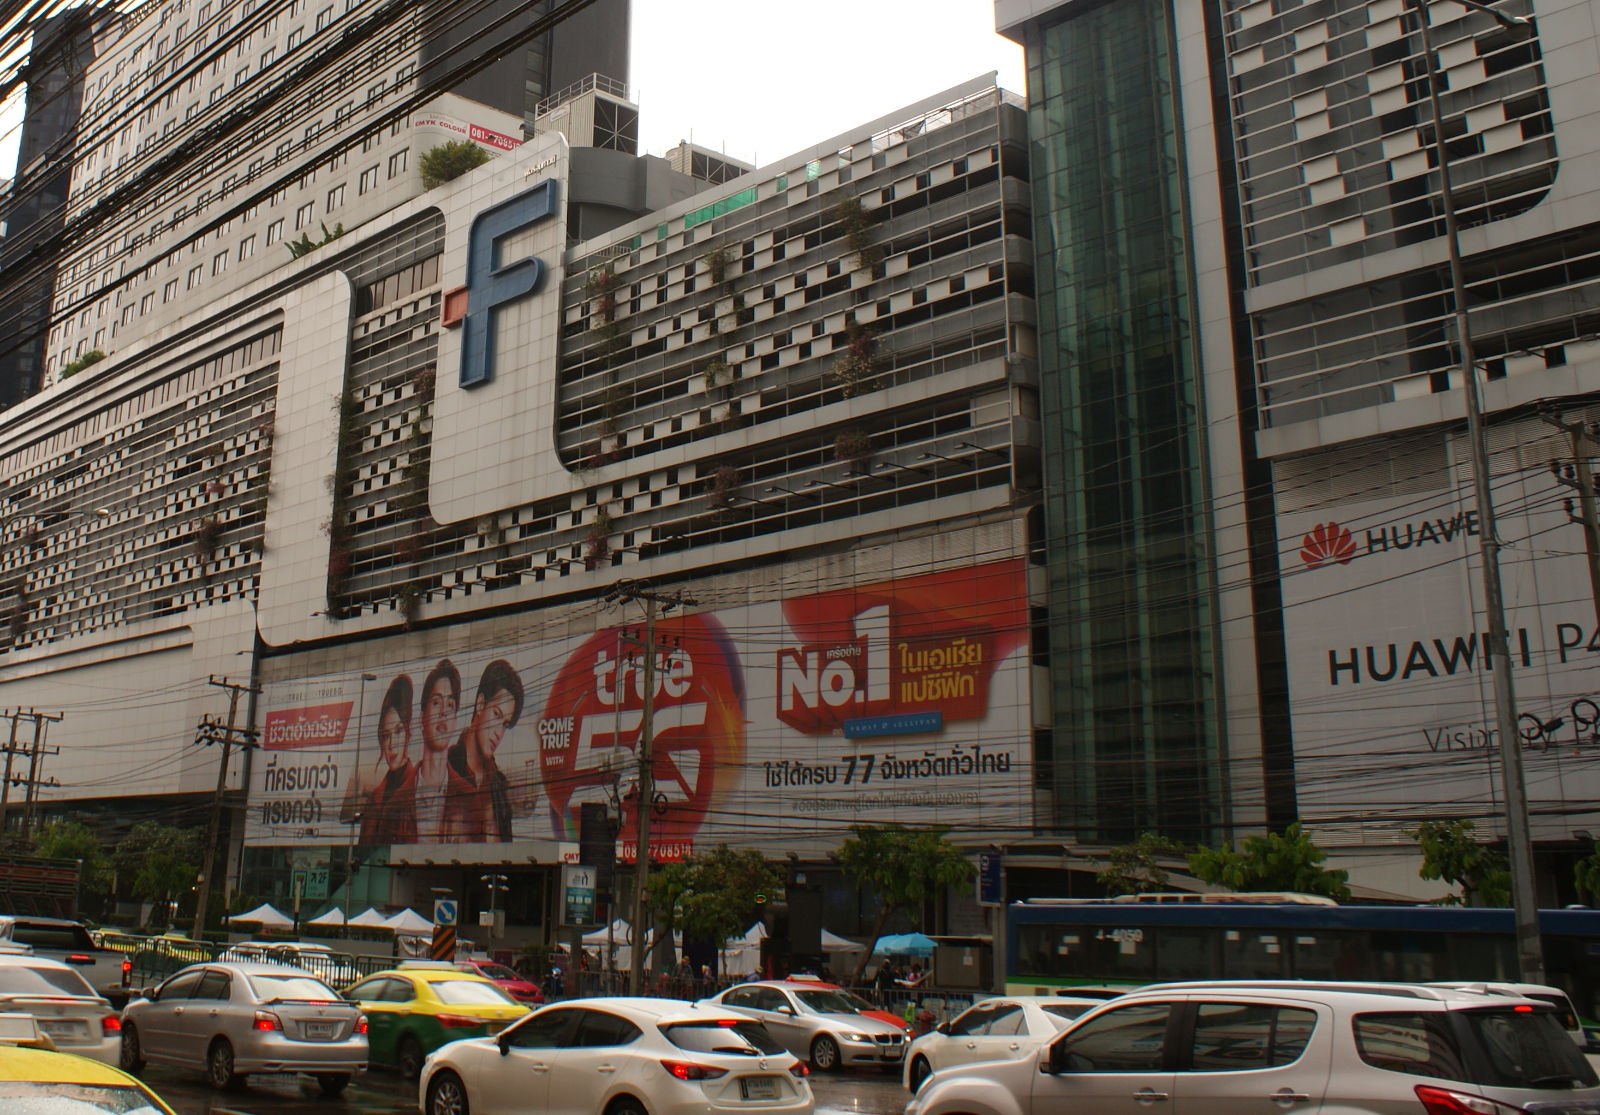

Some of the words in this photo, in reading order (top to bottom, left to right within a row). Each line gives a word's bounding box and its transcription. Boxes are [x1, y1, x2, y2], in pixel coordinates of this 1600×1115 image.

[1365, 510, 1482, 553] HUAWE
[898, 637, 982, 674] ในเอเชีย
[594, 648, 694, 705] true
[538, 716, 575, 735] COME
[541, 733, 571, 750] TRUE
[265, 755, 338, 791] ที่ครบกว่า
[545, 755, 565, 767] WITH
[763, 757, 837, 788] ใช้ได้ครบ
[841, 754, 876, 785] 77
[881, 744, 1011, 781] จังหวัดทั่วไทย
[262, 791, 322, 825] แรงกว่า
